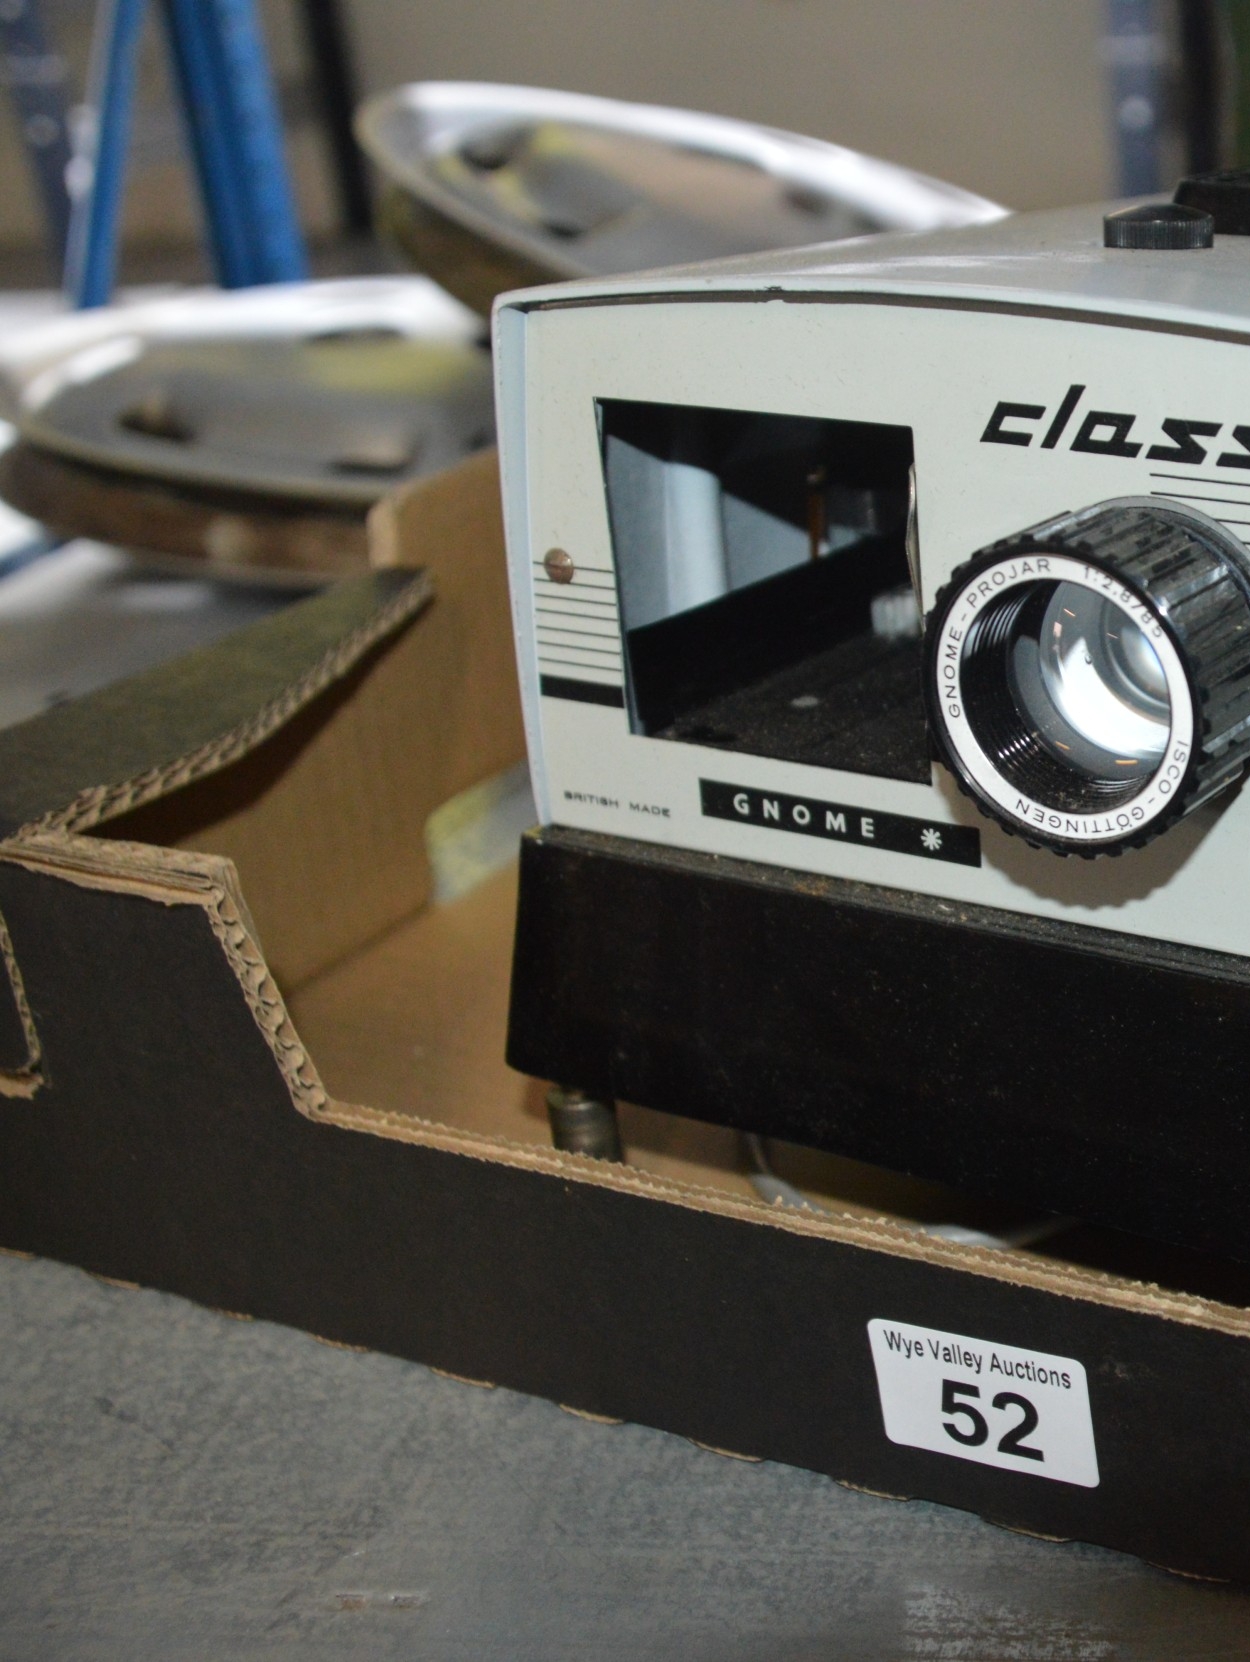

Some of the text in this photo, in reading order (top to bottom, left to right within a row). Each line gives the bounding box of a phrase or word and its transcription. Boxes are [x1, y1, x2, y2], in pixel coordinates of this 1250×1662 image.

[563, 789, 672, 818] BRITISH MADE
[732, 792, 876, 839] GNOME
[883, 1329, 1072, 1390] Wye Valley Auctions
[941, 1378, 1045, 1463] 52
